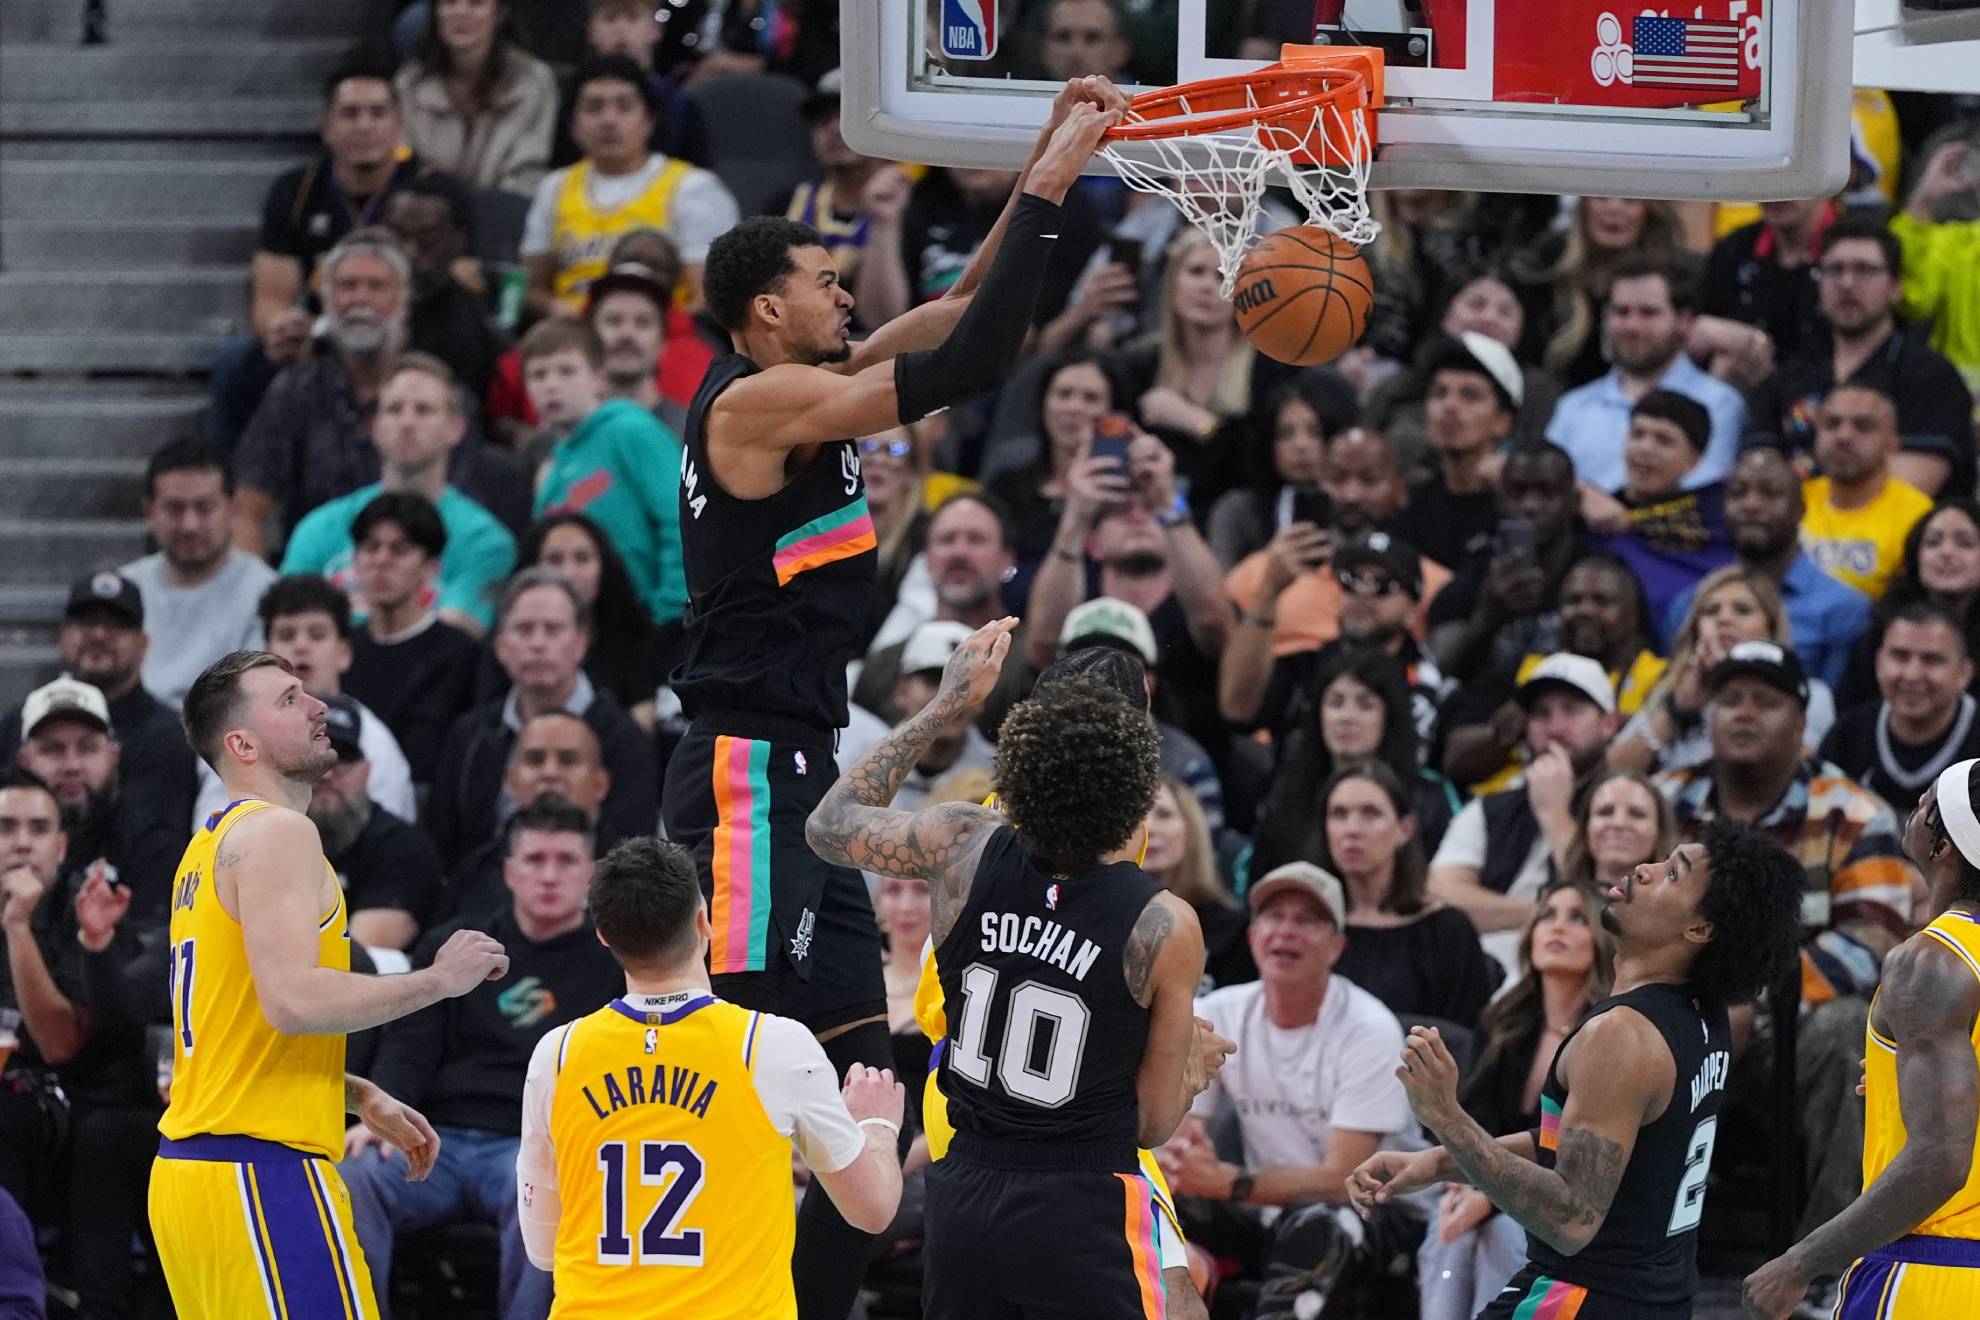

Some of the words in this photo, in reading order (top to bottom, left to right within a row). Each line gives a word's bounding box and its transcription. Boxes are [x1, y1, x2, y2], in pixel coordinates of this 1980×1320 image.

[948, 26, 976, 50] NBA
[981, 911, 1102, 982] SOCHAN
[644, 996, 667, 1006] NIKE
[668, 992, 689, 1004] PRO
[949, 962, 1092, 1110] 10
[582, 1064, 718, 1120] LARAVIA
[597, 1140, 707, 1268] 12
[1666, 1113, 1718, 1238] 2
